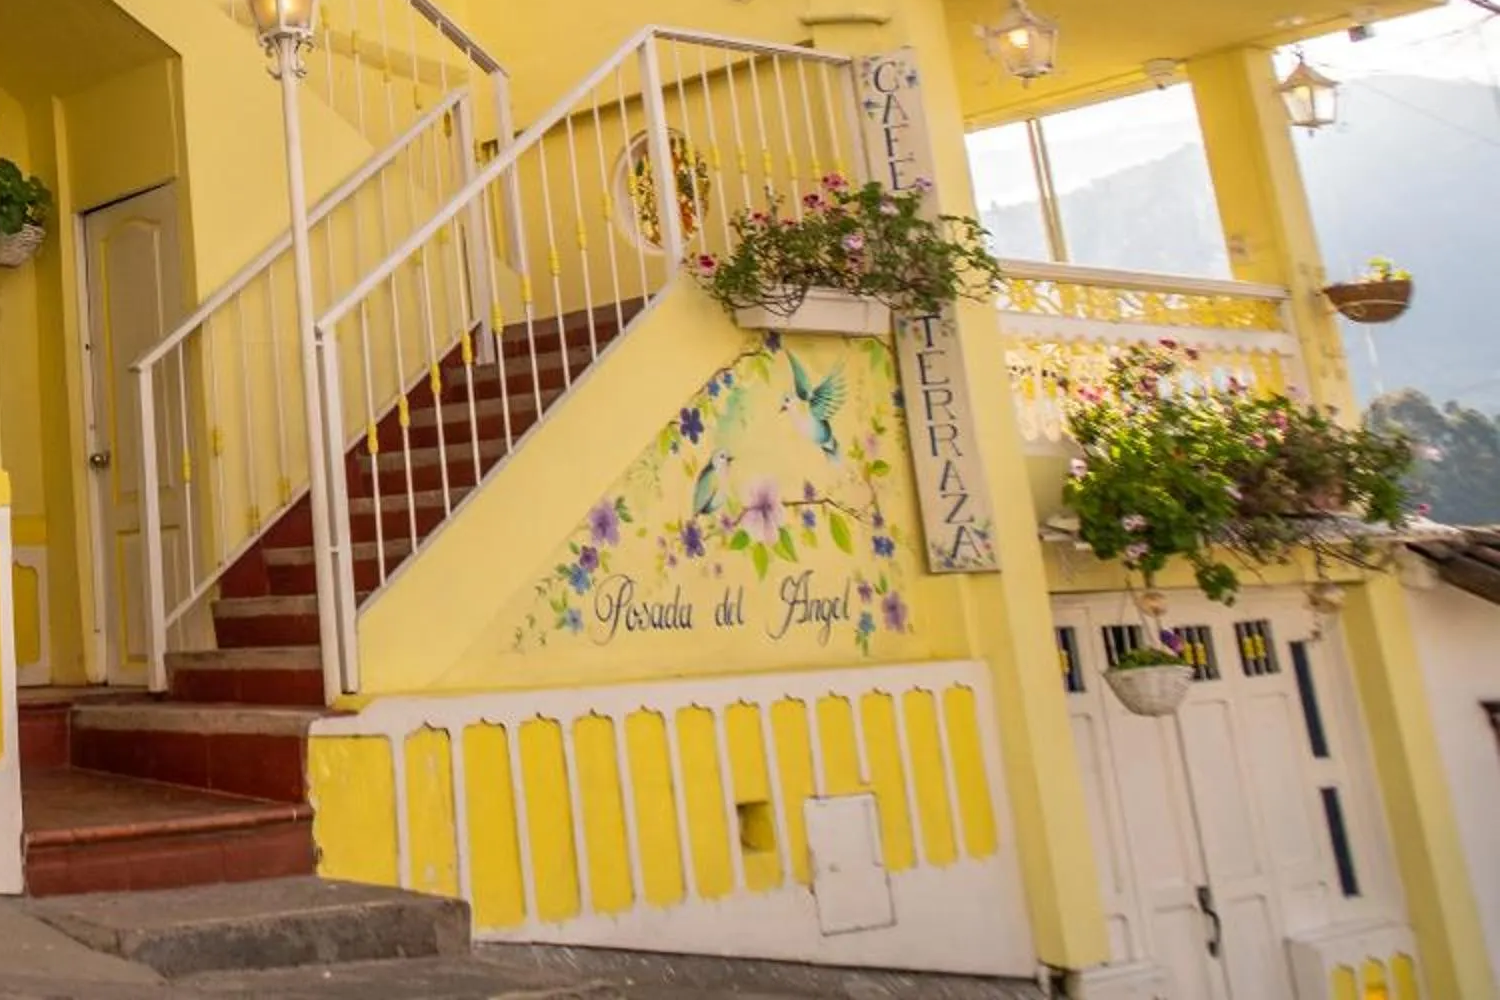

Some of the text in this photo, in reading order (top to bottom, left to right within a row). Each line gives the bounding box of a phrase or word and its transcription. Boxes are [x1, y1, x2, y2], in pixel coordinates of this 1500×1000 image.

[908, 315, 981, 559] TERRAZA
[591, 569, 852, 648] Posada del Angel
